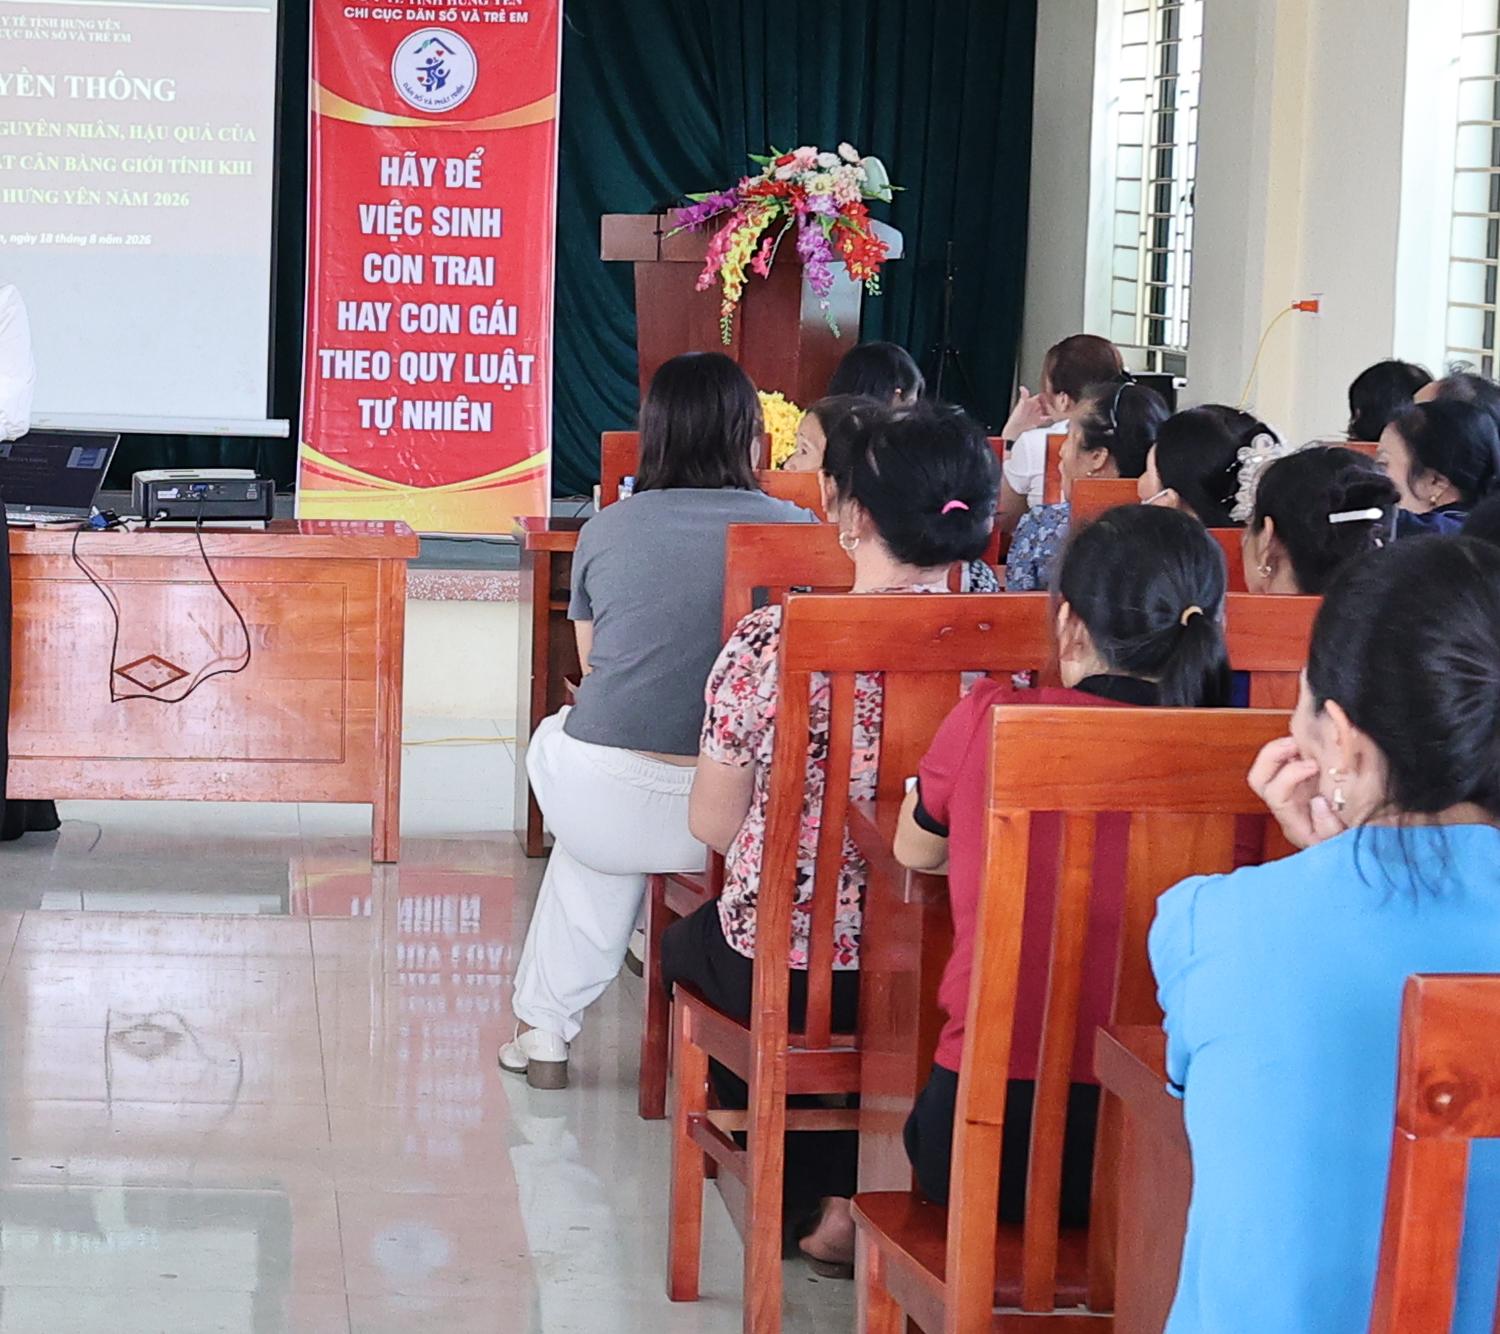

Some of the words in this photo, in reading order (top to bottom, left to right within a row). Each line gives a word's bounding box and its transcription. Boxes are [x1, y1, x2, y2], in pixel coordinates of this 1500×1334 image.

[344, 7, 368, 19] CHI
[372, 8, 403, 23] CỤC
[406, 8, 435, 21] DÂN
[439, 8, 458, 22] SỐ
[461, 8, 480, 22] VÀ
[483, 8, 506, 23] TRẺ
[509, 11, 529, 23] EM
[64, 69, 176, 102] THÔNG
[380, 149, 435, 189] HÃY
[445, 146, 486, 189] ĐỂ
[3, 187, 59, 205] HƯNG
[64, 187, 101, 205] YÊN
[106, 188, 149, 206] NĂM
[154, 192, 190, 207] 2026
[359, 199, 423, 243] VIỆC
[431, 207, 502, 239] SINH
[363, 253, 426, 286] CON
[432, 254, 494, 286] TRAI
[338, 301, 391, 332] HAY
[400, 301, 460, 335] CON
[469, 299, 517, 336] GÁI
[319, 348, 391, 381] THEO
[400, 351, 456, 386] QUY
[465, 347, 535, 391] LUẬT
[359, 395, 397, 435] TỰ
[403, 395, 492, 433] NHIÊN
